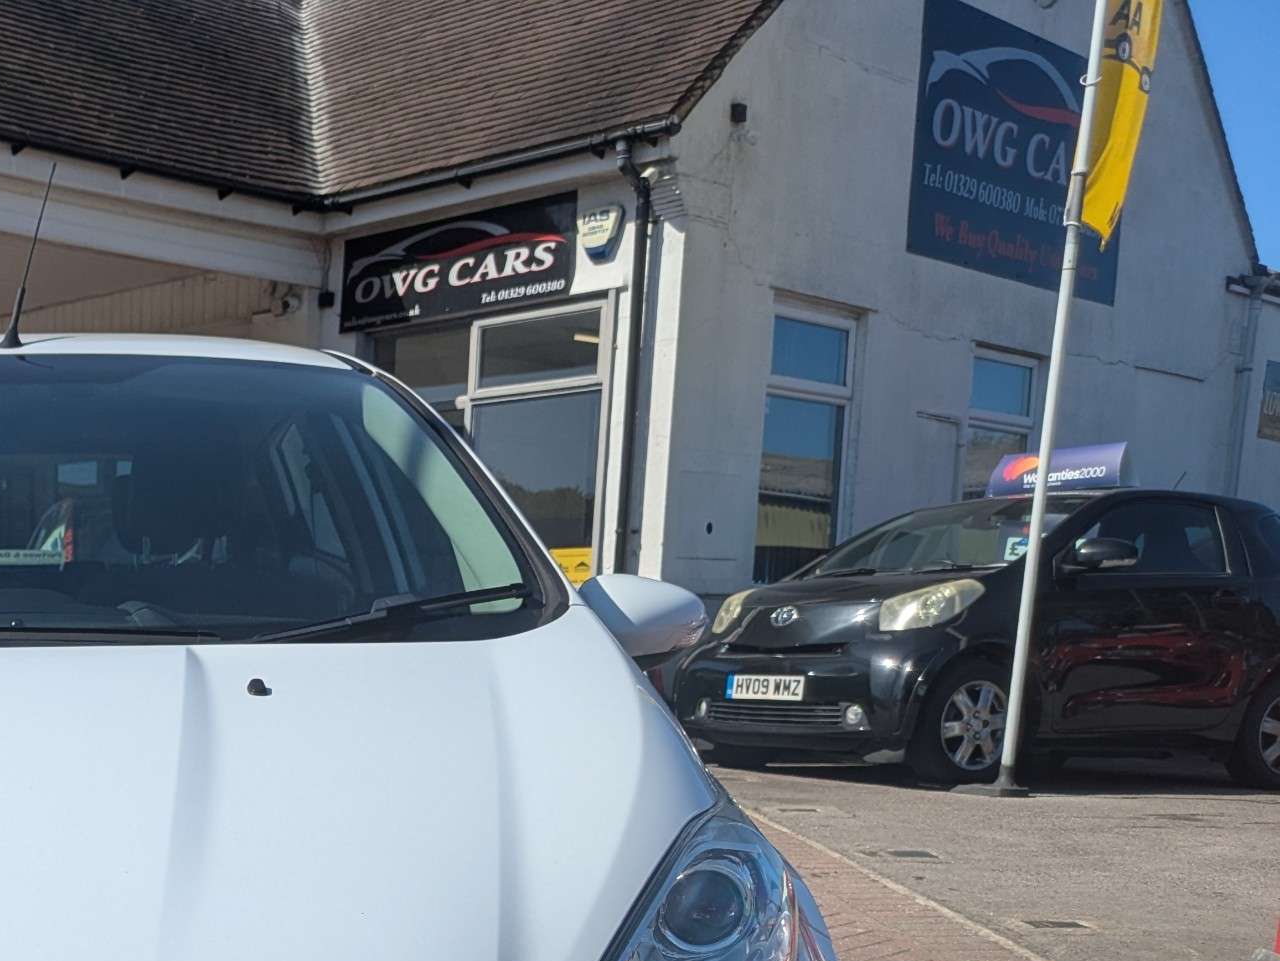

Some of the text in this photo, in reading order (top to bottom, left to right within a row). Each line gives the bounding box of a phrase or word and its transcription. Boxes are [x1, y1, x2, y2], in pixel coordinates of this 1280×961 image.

[932, 99, 1068, 186] OWG CA
[923, 163, 942, 188] Tel:
[945, 170, 977, 201] 01329
[978, 181, 1021, 214] 600380
[354, 241, 556, 304] OWG CARS
[497, 286, 525, 301] 01329
[526, 279, 566, 296] 600380
[1023, 466, 1106, 484] Waanties2000
[735, 678, 801, 696] HV09 WMZ
